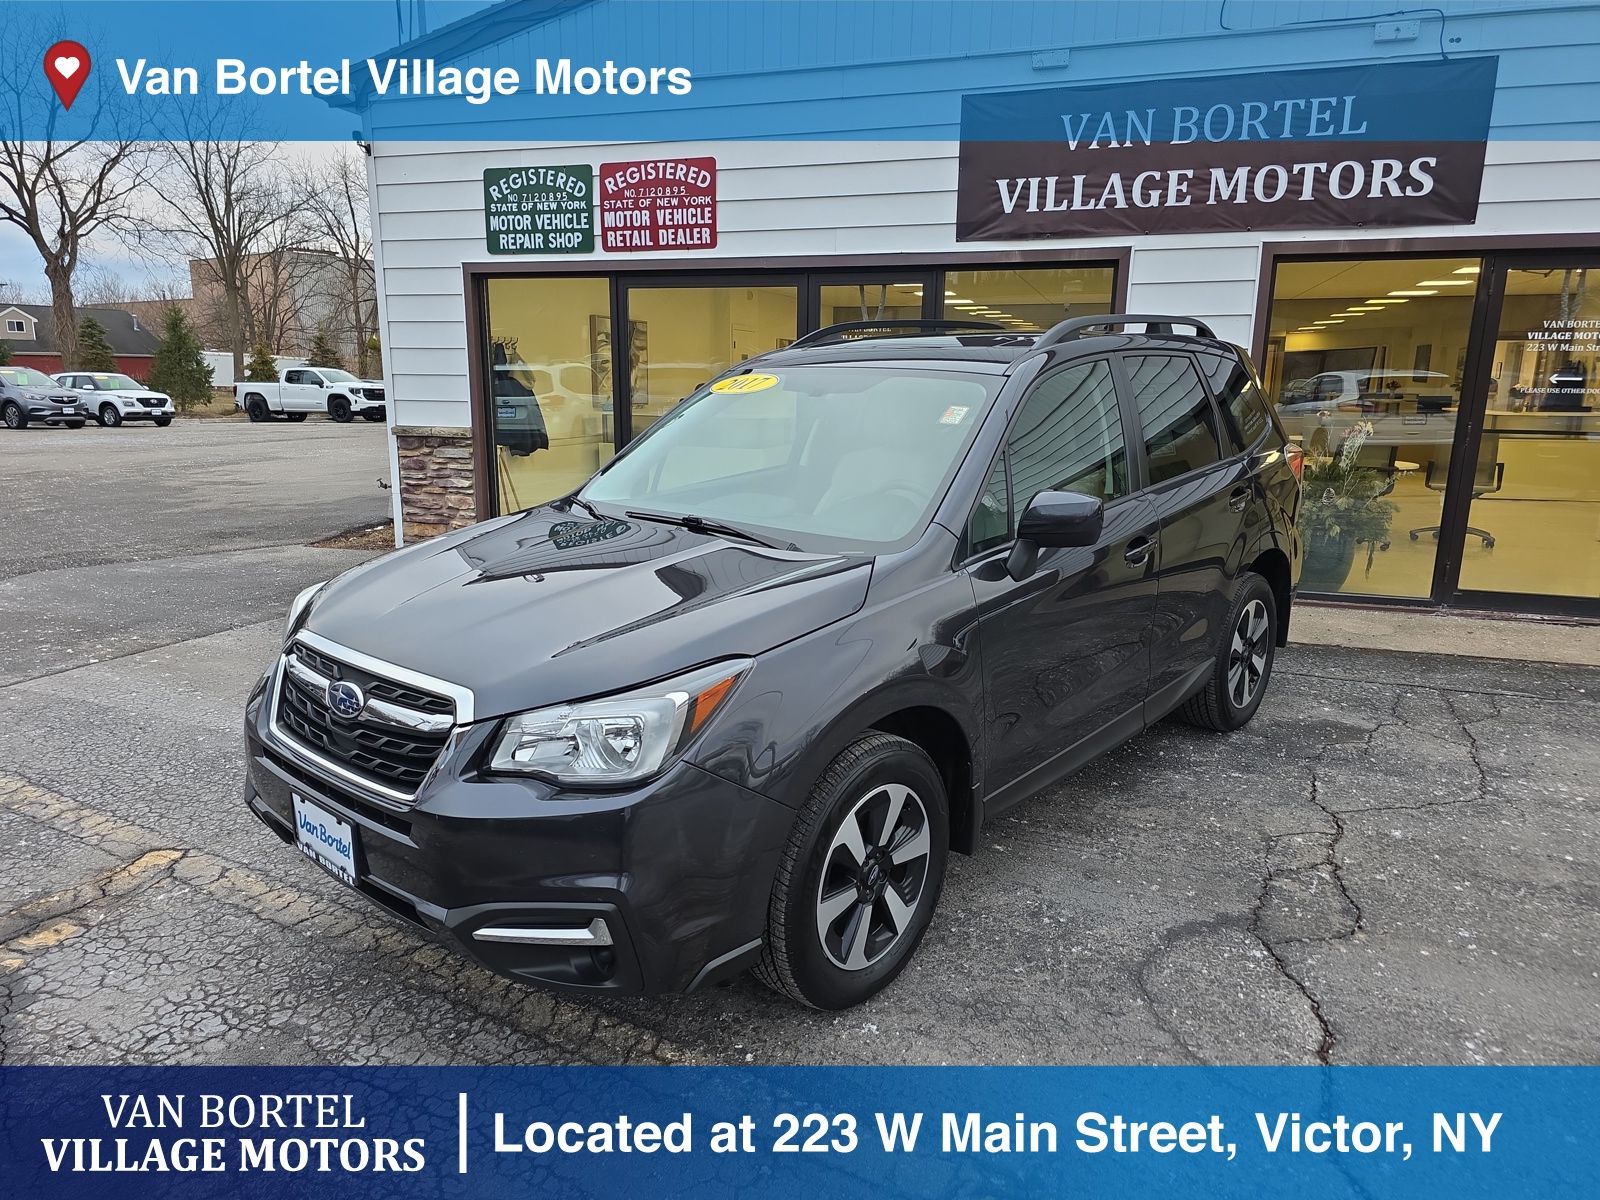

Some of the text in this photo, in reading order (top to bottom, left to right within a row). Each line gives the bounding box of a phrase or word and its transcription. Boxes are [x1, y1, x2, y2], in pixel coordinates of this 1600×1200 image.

[1061, 95, 1368, 151] VAN BORTEL
[488, 168, 586, 201] REGISTERED
[604, 162, 711, 194] REGISTERED
[995, 156, 1437, 214] VILLAGE MOTORS
[521, 191, 568, 202] 7120895
[624, 186, 687, 198] NO. 7120895
[490, 201, 587, 212] STATE OF NEW YORK
[603, 196, 712, 209] STATE OF NEW YORK
[489, 212, 589, 231] MOTOR VEHICLE
[603, 207, 713, 228] MOTOR VEHICLE
[499, 231, 583, 250] REPAIR SHOP
[607, 227, 711, 247] RETAIL DEALER
[1543, 320, 1564, 328] VAN
[1527, 331, 1600, 340] VILLAGE MOT
[1526, 344, 1545, 352] 223
[1547, 344, 1558, 352] W
[1560, 344, 1584, 352] Main
